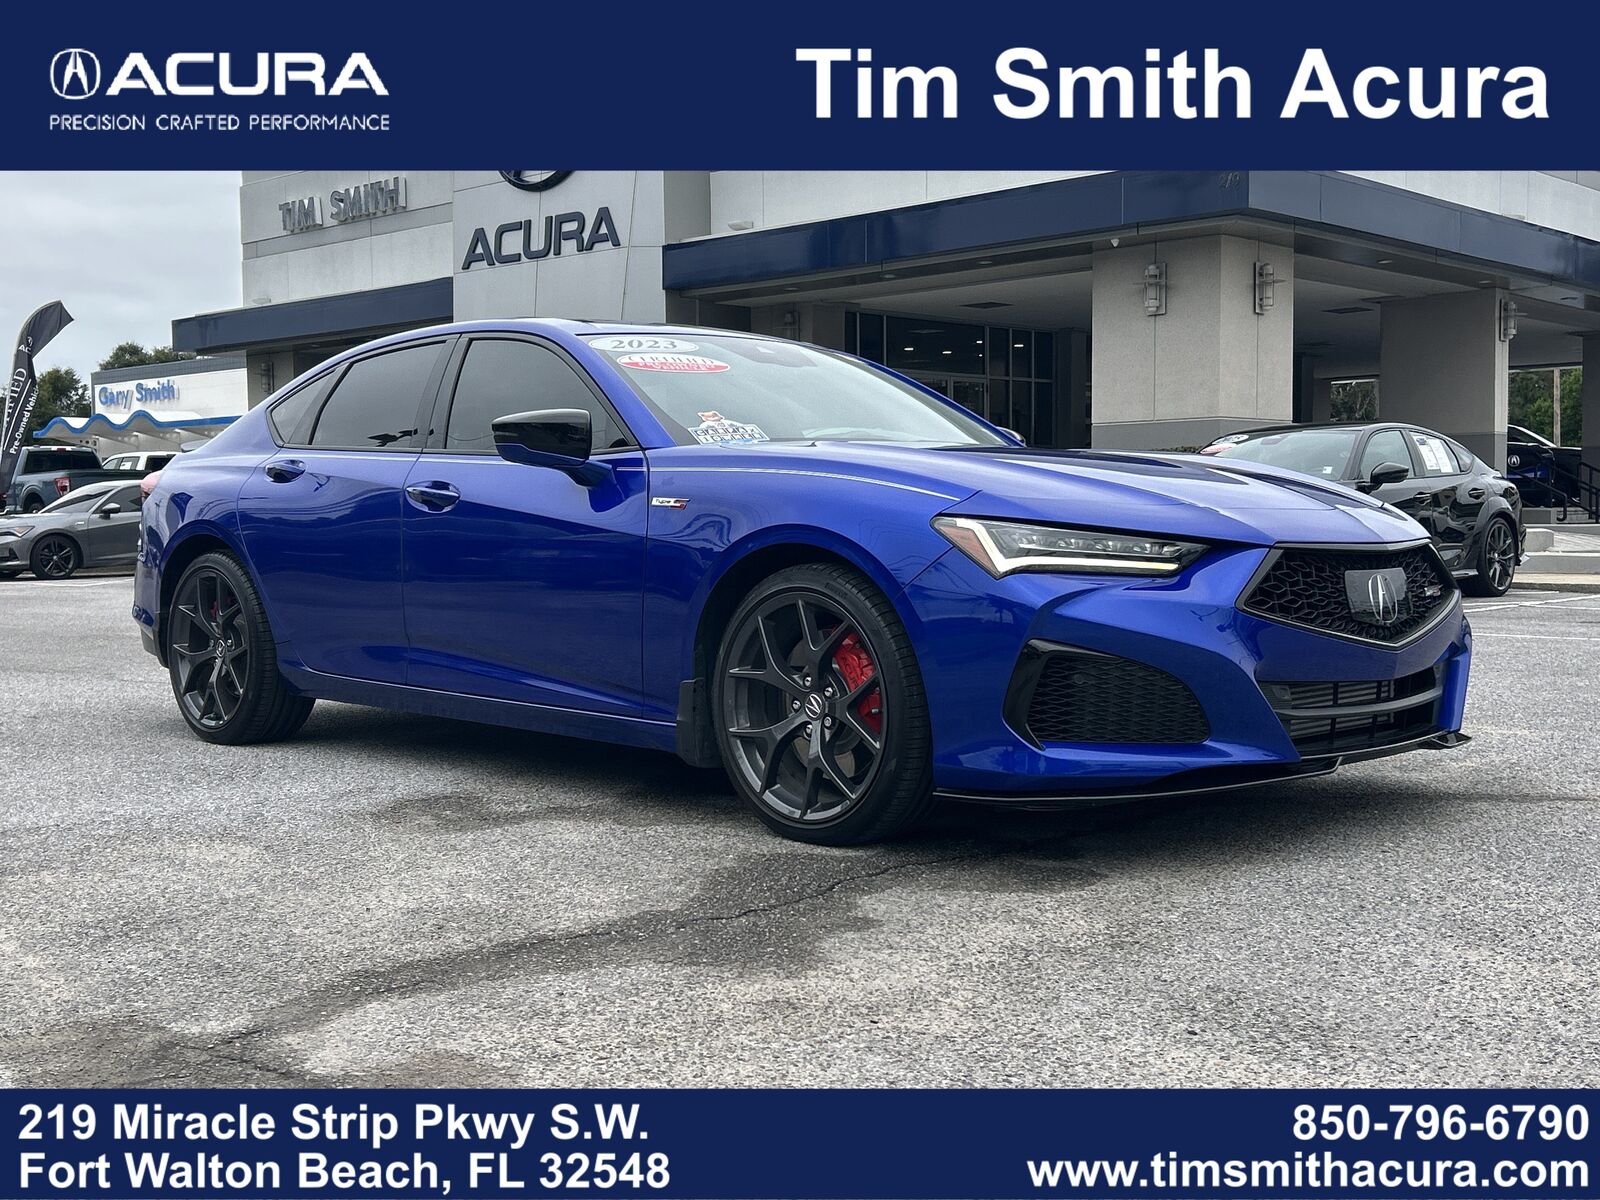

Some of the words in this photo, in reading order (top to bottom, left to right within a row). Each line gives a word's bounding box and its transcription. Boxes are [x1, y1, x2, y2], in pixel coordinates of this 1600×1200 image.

[279, 197, 321, 232] TIM
[329, 176, 405, 223] SMITH
[461, 206, 621, 270] ACURA
[610, 339, 678, 349] 2023
[98, 386, 131, 409] Gary
[136, 379, 176, 402] Smith
[9, 410, 31, 454] Pre-Owned
